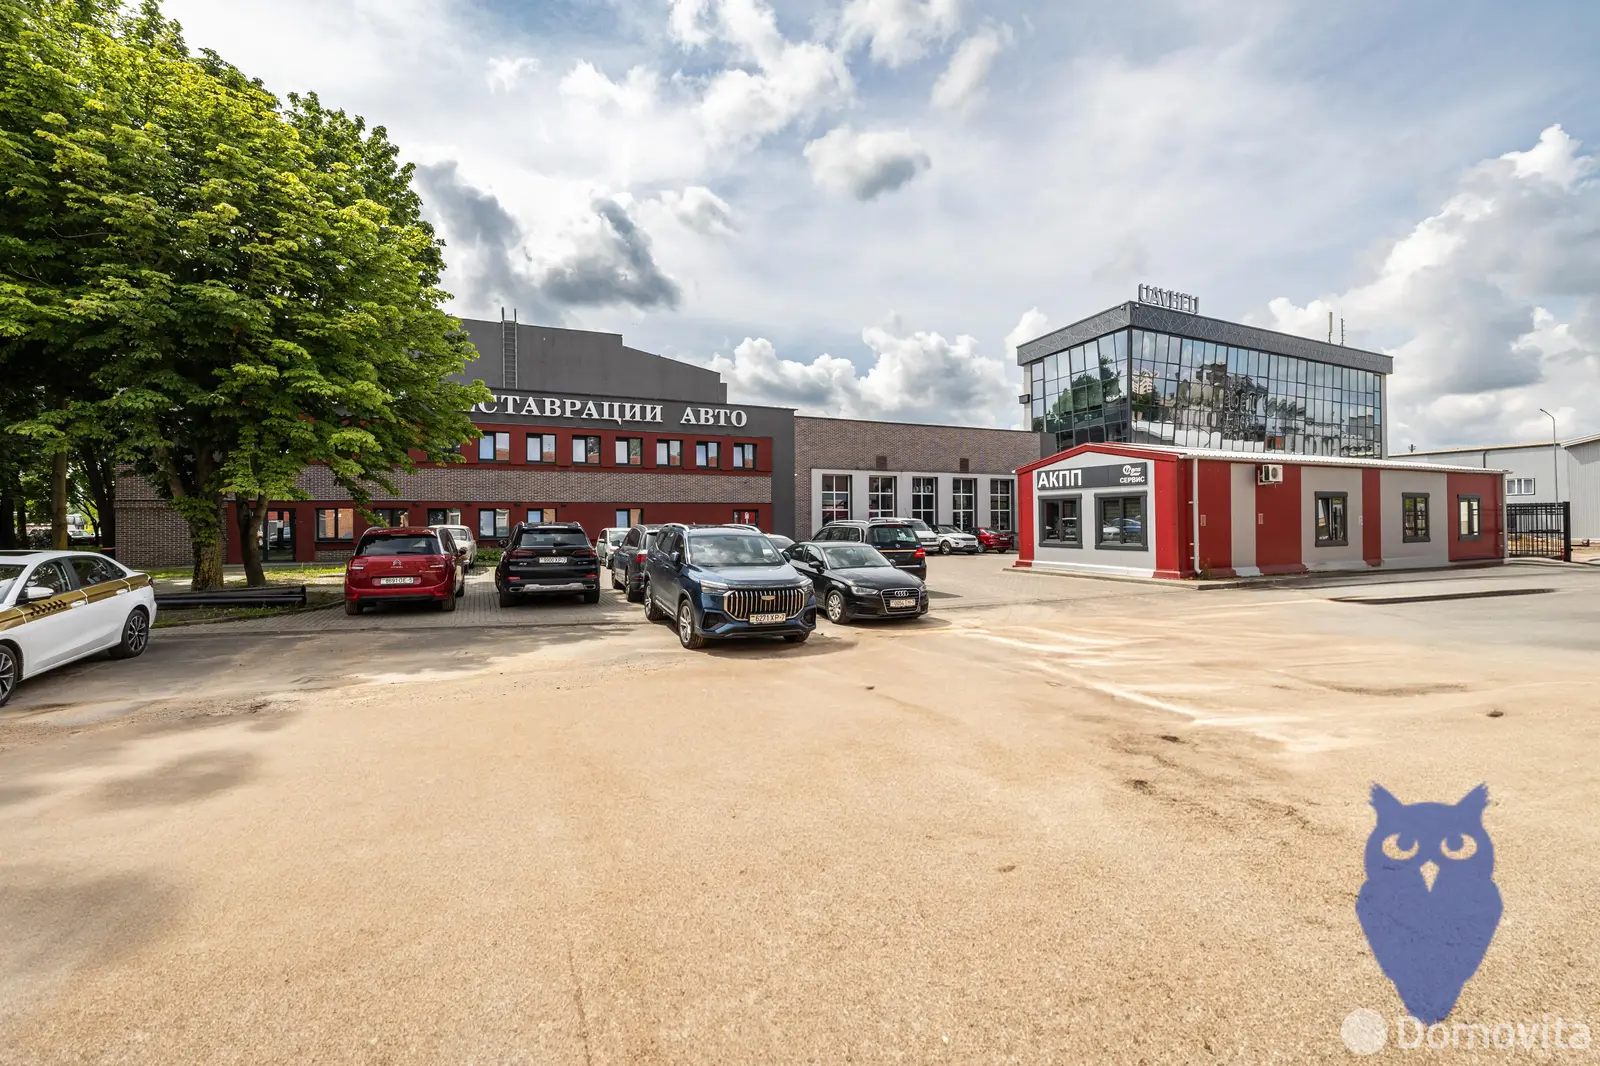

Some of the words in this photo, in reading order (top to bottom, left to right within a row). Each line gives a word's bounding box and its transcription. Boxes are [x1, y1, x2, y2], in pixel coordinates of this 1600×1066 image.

[464, 394, 663, 425] СТАВРАЦИИ
[680, 406, 747, 427] АВТО
[1037, 469, 1082, 488] АКПП
[1120, 476, 1145, 484] СЕРВИС
